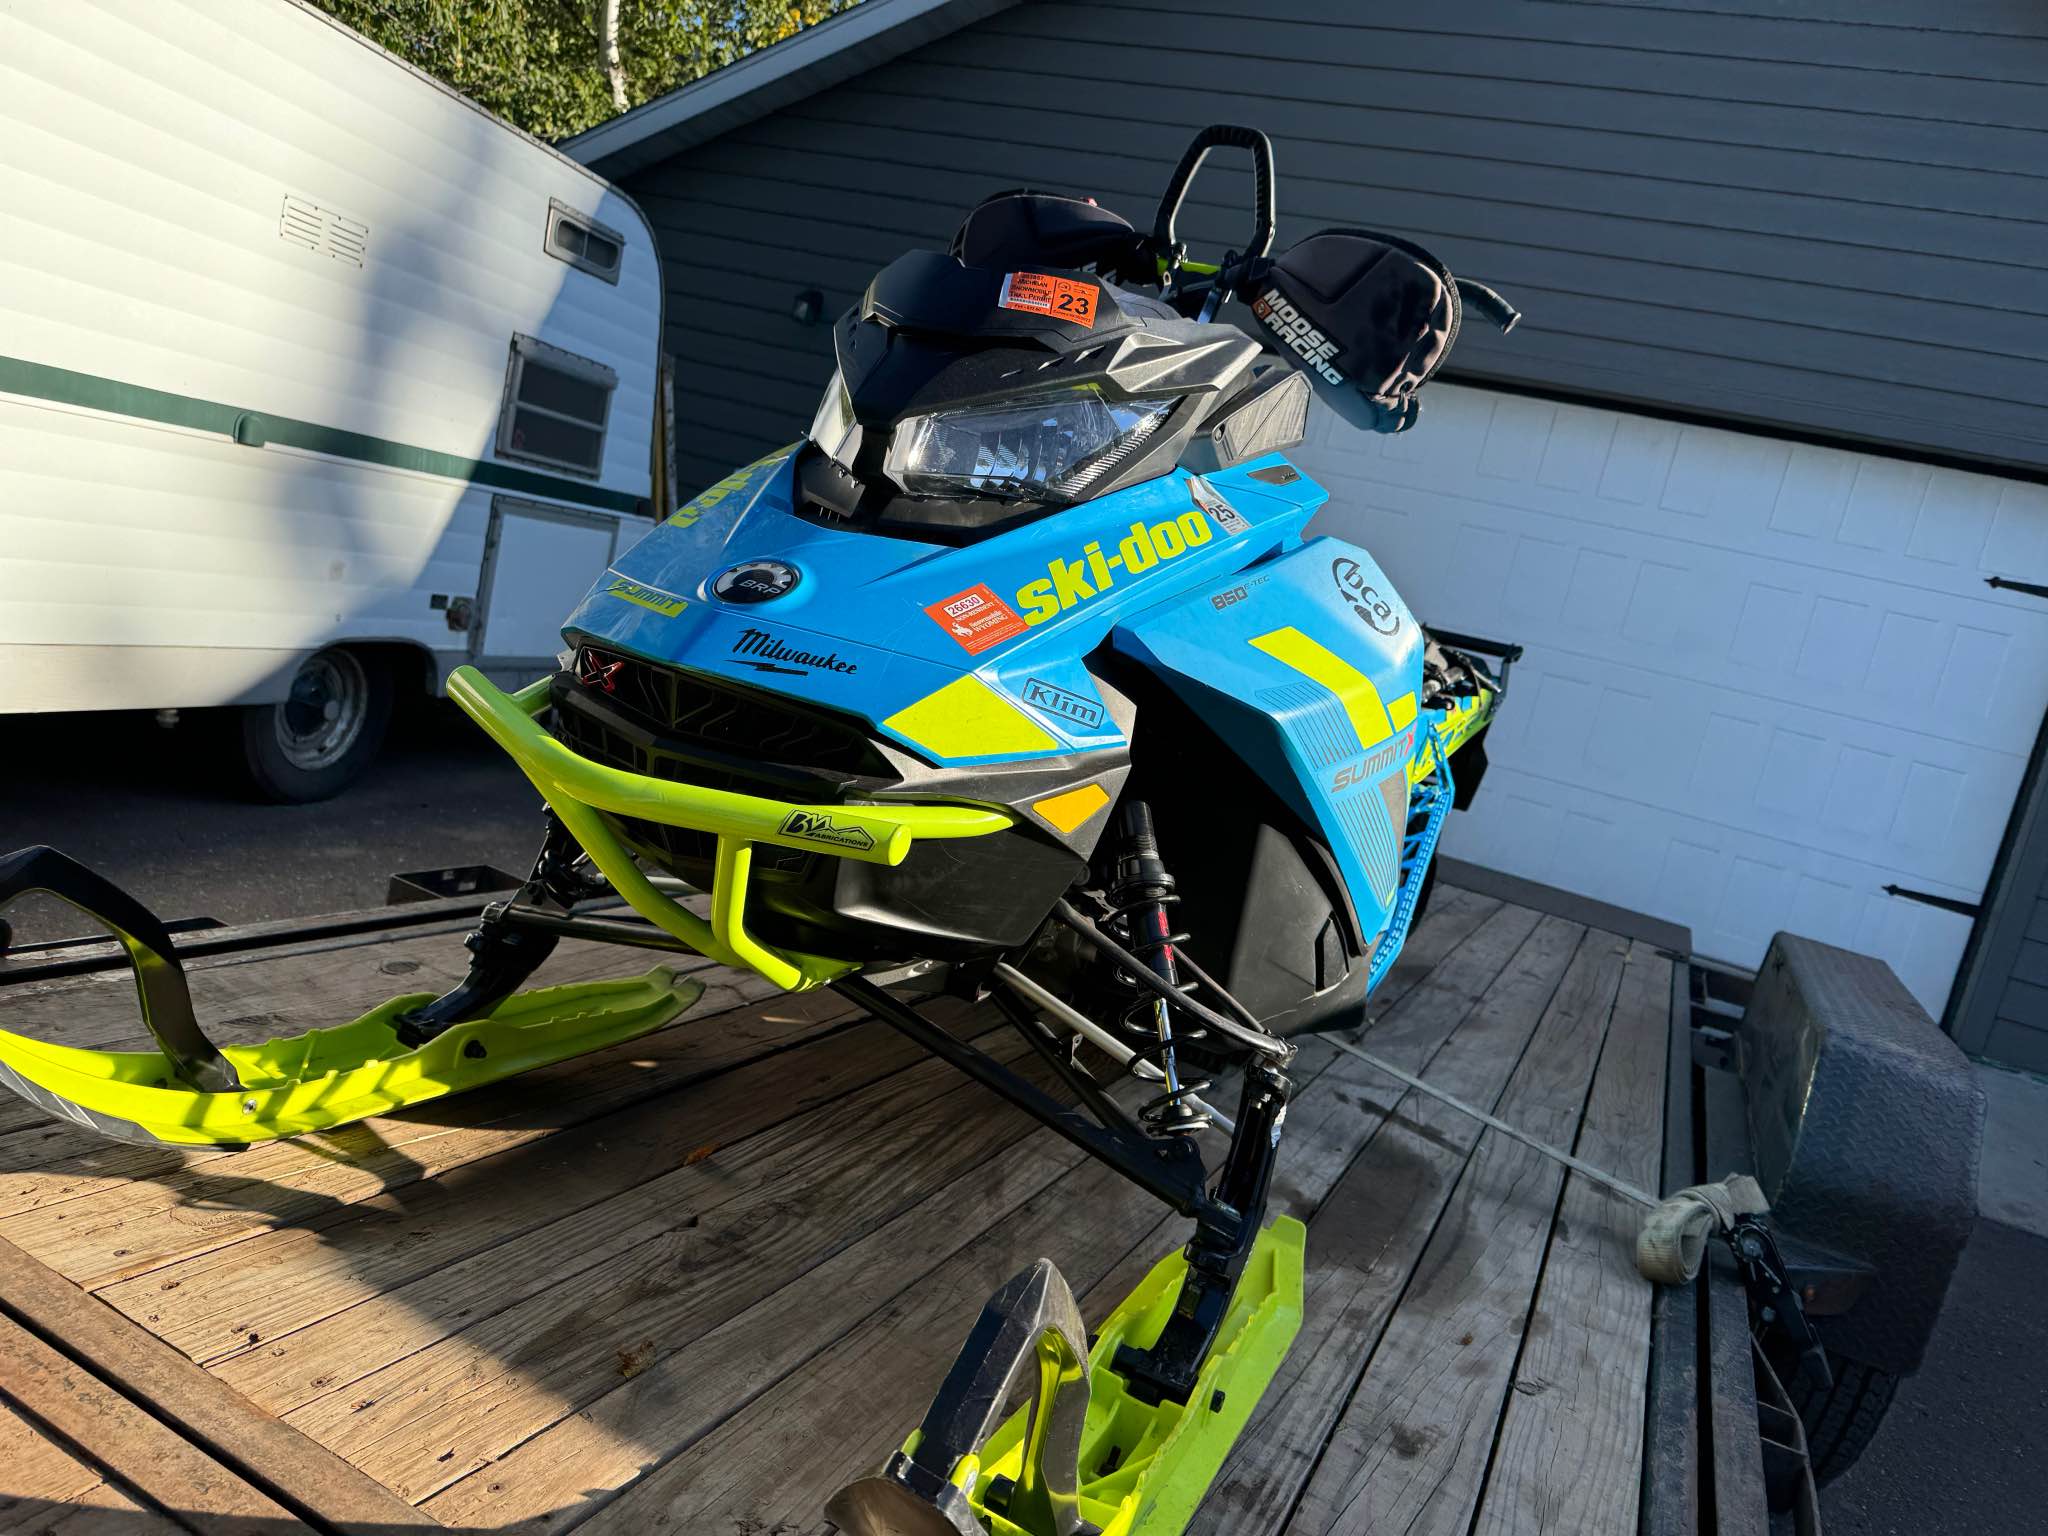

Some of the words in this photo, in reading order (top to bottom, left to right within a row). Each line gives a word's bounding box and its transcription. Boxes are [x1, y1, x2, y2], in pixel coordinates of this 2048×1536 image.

[1057, 293, 1089, 315] 23
[1263, 288, 1339, 360] MOOSE
[1264, 312, 1343, 385] RACING
[1208, 504, 1236, 523] 25
[739, 579, 781, 595] BRP
[1016, 511, 1213, 627] ski-doo
[1342, 563, 1393, 622] bca
[947, 596, 981, 616] 26630
[973, 614, 1009, 633] WYOMING
[732, 628, 858, 675] Milwaukee
[1331, 736, 1407, 793] SUMMIT
